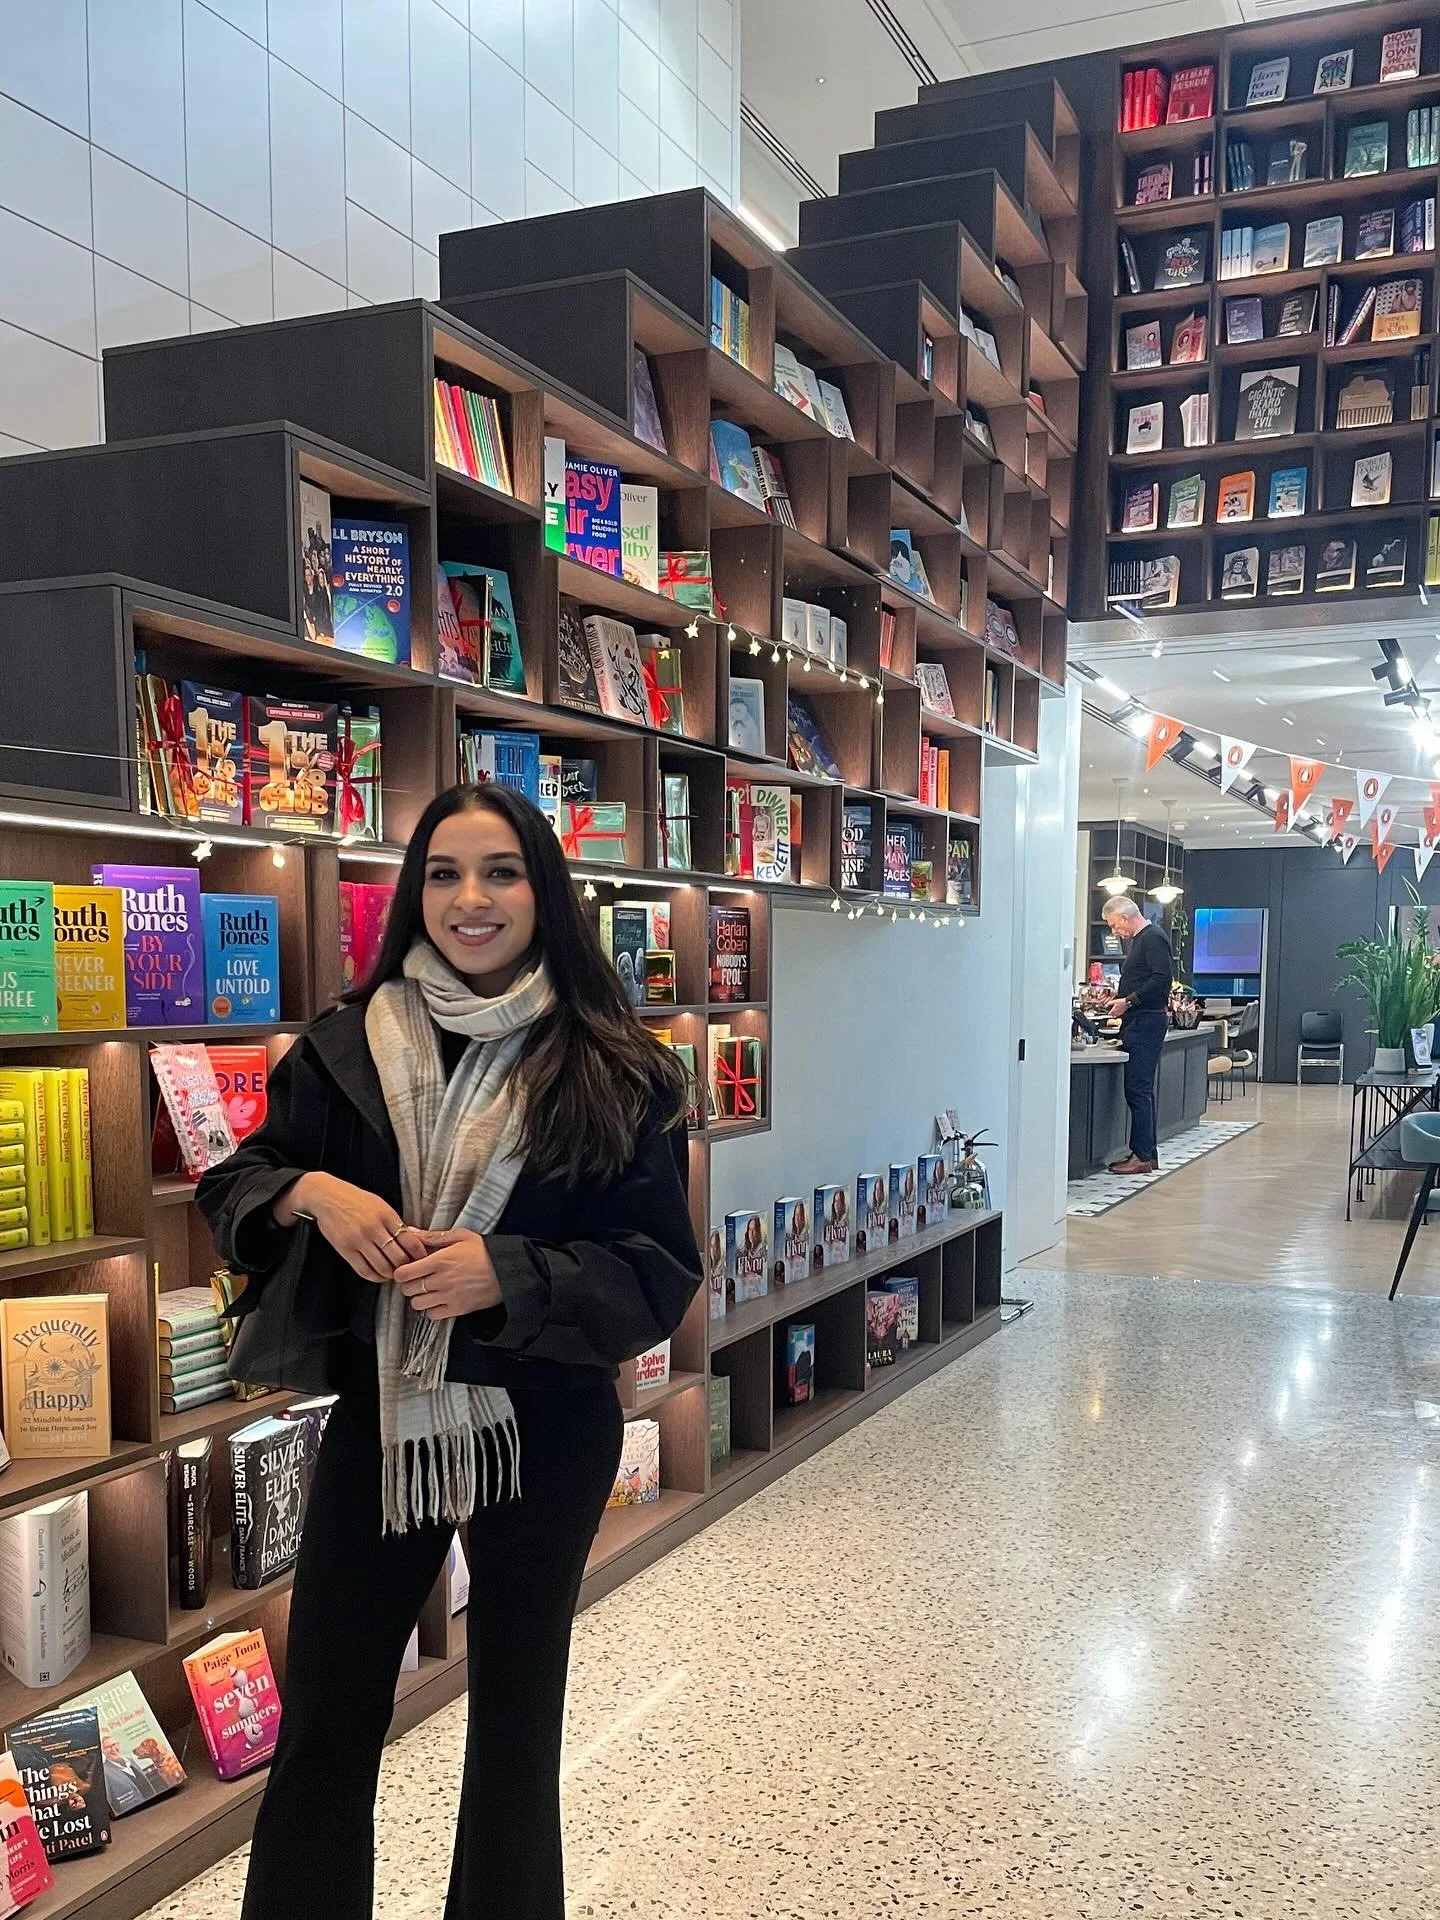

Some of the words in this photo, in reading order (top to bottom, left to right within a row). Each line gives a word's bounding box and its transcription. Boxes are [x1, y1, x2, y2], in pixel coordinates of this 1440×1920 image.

[1386, 30, 1415, 43] HOW
[1385, 45, 1416, 58] OWN
[1253, 69, 1285, 82] dare
[1382, 62, 1417, 78] ROOM
[1251, 80, 1265, 90] to
[1318, 75, 1346, 89] ALS
[1249, 85, 1280, 99] lead
[1248, 386, 1287, 401] GIGANTIC
[1262, 380, 1275, 390] THE
[1248, 408, 1266, 419] THAT
[1267, 406, 1281, 417] WAS
[1251, 397, 1281, 410] BEARD
[1253, 416, 1273, 429] EVIL
[565, 461, 588, 473] JAMIE
[589, 465, 618, 478] OLIVER
[565, 470, 613, 511] asy
[332, 528, 348, 541] LL
[351, 529, 403, 545] BRYSON
[591, 531, 607, 539] FOOD
[622, 525, 651, 541] self
[352, 546, 359, 554] A
[361, 546, 390, 556] SHORT
[623, 542, 653, 561] lthy
[345, 554, 390, 566] HISTORY
[391, 558, 402, 567] OF
[367, 564, 402, 575] NEARLY
[345, 572, 405, 585] EVERYTHING
[385, 585, 403, 597] 2.0
[208, 718, 237, 741] THE
[288, 730, 328, 750] THE
[259, 782, 329, 815] CLUB
[756, 789, 789, 837] DINNER
[841, 828, 864, 842] OD
[886, 835, 906, 848] HER
[841, 841, 857, 855] AR
[841, 858, 864, 873] ISE
[884, 852, 910, 865] MANY
[841, 872, 859, 887] NA
[884, 869, 910, 882] FACES
[122, 883, 188, 914] Ruth
[0, 898, 40, 925] uth
[54, 902, 109, 928] Ruth
[122, 911, 189, 942] Jones
[219, 910, 268, 932] Ruth
[716, 920, 748, 937] Harlan
[0, 923, 41, 942] nes
[54, 925, 110, 943] ones
[219, 930, 270, 952] Jones
[142, 935, 165, 953] BY
[716, 935, 748, 952] Coben
[55, 956, 105, 973] NEVER
[126, 953, 183, 972] YOUR
[226, 959, 259, 977] LOVE
[716, 954, 747, 968] NOBODY'S
[56, 975, 115, 992] REENER
[133, 972, 176, 990] SIDE
[721, 968, 743, 986] FOOL
[215, 978, 270, 995] UNTOLD
[0, 990, 36, 1008] REE
[215, 1072, 264, 1094] ORE
[37, 1082, 45, 1112] After
[61, 1080, 69, 1112] After
[81, 1078, 89, 1110] After
[62, 1112, 70, 1131] the
[39, 1134, 47, 1167] Spike
[62, 1131, 70, 1164] Spike
[82, 1130, 90, 1161] Spike
[904, 1307, 917, 1315] THE
[13, 1319, 101, 1349] Frequently
[641, 1353, 666, 1368] Solve
[868, 1348, 893, 1360] LAURA
[636, 1365, 666, 1381] urders
[33, 1390, 91, 1412] Happy
[29, 1425, 50, 1434] Bring
[51, 1424, 70, 1433] Hope
[86, 1424, 98, 1433] Joy
[63, 1416, 97, 1424] Moments
[260, 1440, 305, 1477] SILVER
[233, 1447, 246, 1490] SILVER
[265, 1467, 300, 1502] ELITE
[235, 1492, 247, 1525] ELITE
[186, 1502, 195, 1546] STAIRCASE
[269, 1515, 299, 1545] DANI
[261, 1532, 303, 1570] FRANCIS
[203, 1652, 233, 1674] Paige
[234, 1639, 262, 1659] Toon
[95, 1680, 133, 1703] aeme
[212, 1674, 271, 1715] seven
[221, 1702, 279, 1740] summers
[18, 1767, 50, 1786] The
[23, 1779, 79, 1805] Things
[32, 1805, 62, 1823] hat
[53, 1815, 92, 1837] Lost
[6, 1838, 29, 1851] KER'S
[58, 1832, 94, 1852] Patel
